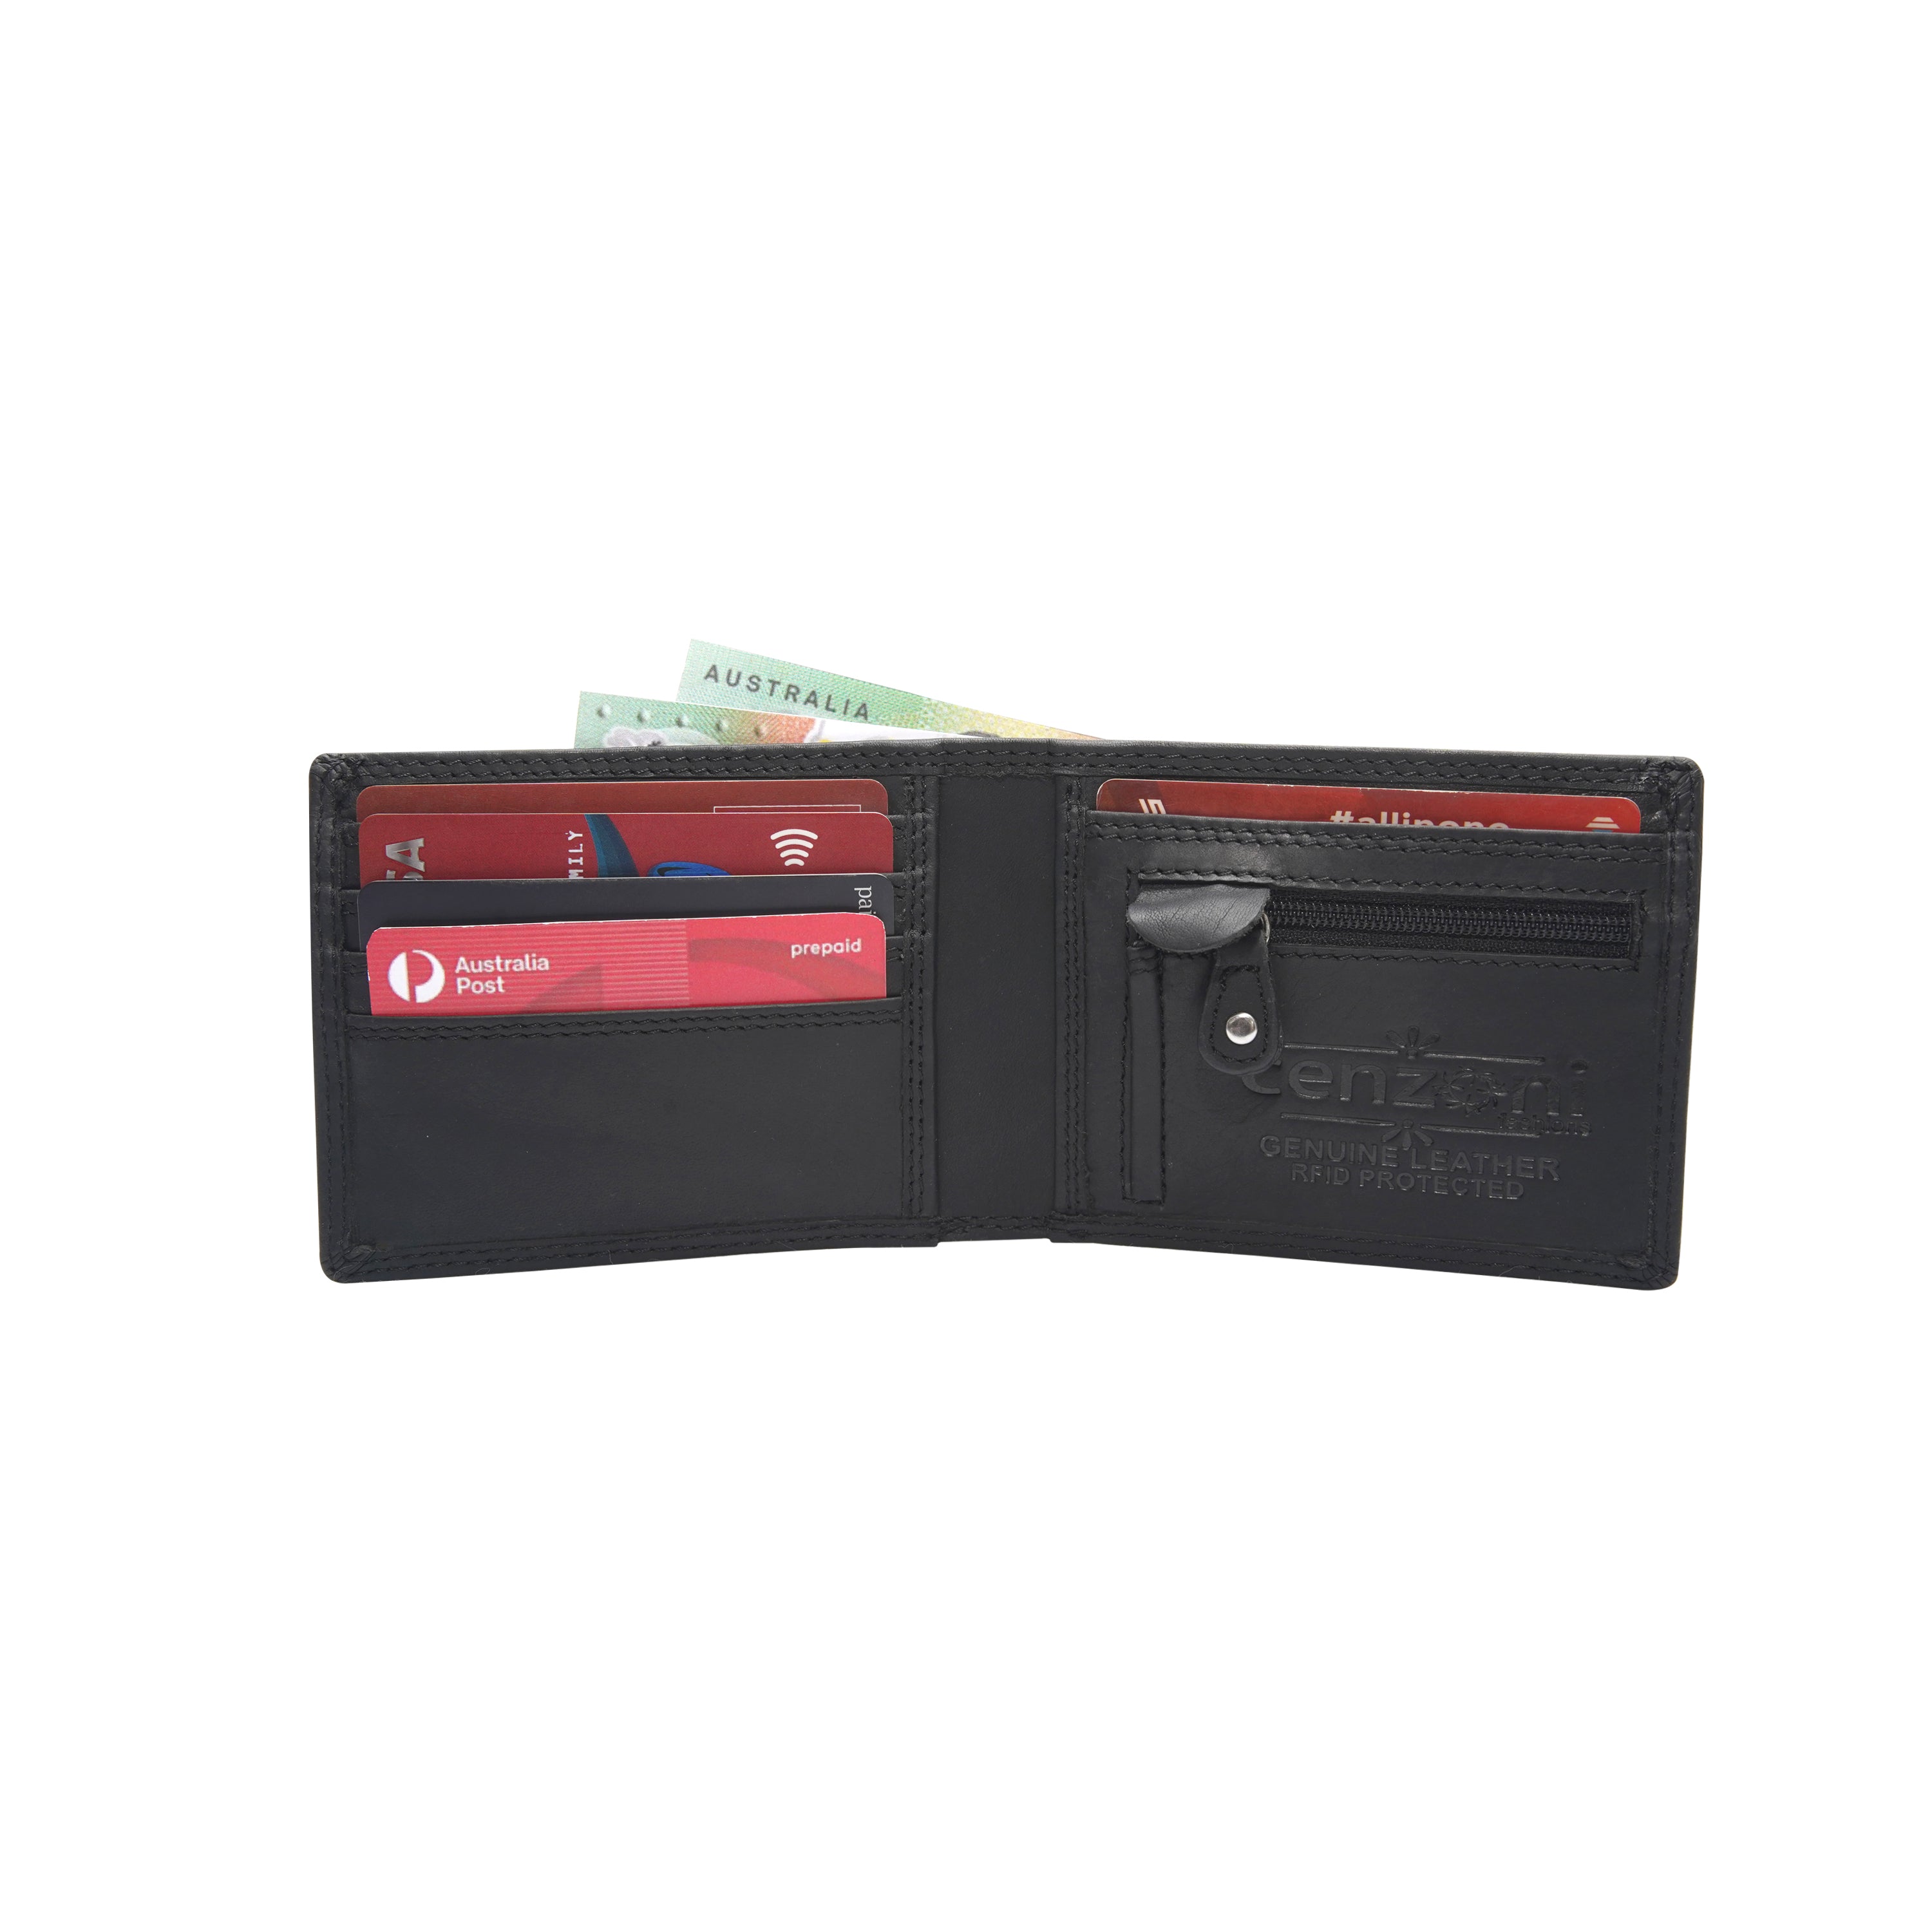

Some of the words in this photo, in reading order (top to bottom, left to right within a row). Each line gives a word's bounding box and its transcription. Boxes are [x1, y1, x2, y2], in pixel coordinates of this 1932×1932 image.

[705, 664, 869, 721] AUSTRALIA
[385, 838, 425, 880] A
[455, 954, 549, 974] Australia
[791, 938, 862, 958] prepaid
[457, 976, 505, 994] Post
[1260, 1135, 1398, 1167] GENUINE
[1412, 1148, 1560, 1181] LEATHER
[1291, 1163, 1350, 1186] RFID
[1359, 1170, 1524, 1199] PROTECTED
